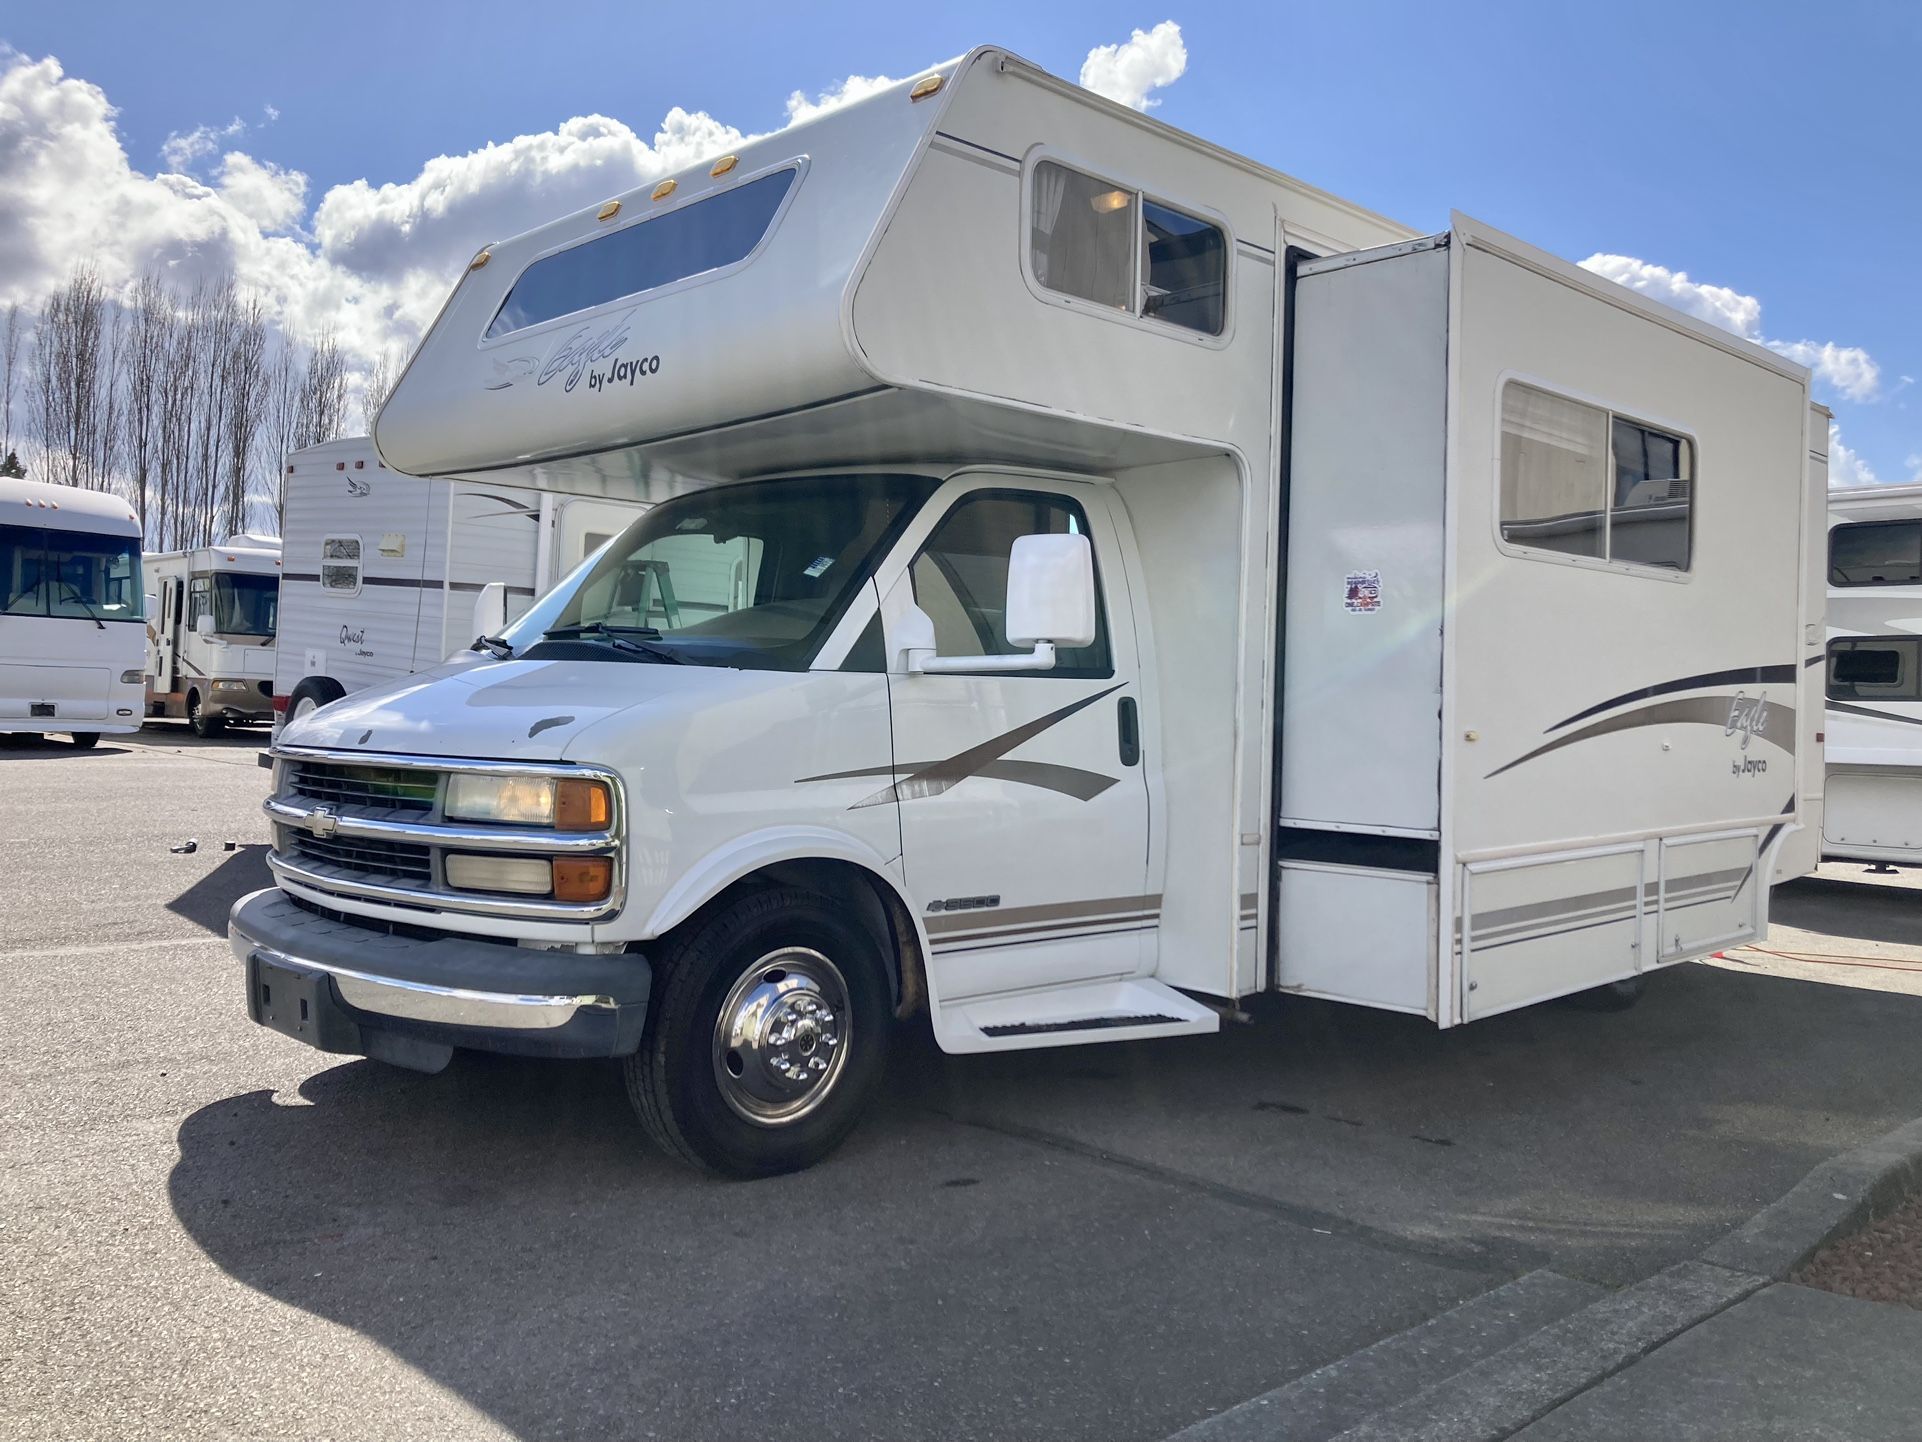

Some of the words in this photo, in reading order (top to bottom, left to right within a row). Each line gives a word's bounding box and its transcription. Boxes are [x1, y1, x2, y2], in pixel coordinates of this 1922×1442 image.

[588, 369, 605, 392] by
[607, 355, 660, 387] Jayco
[1725, 690, 1768, 750] Eagle
[1732, 760, 1741, 778] by
[1742, 755, 1767, 778] Jayco
